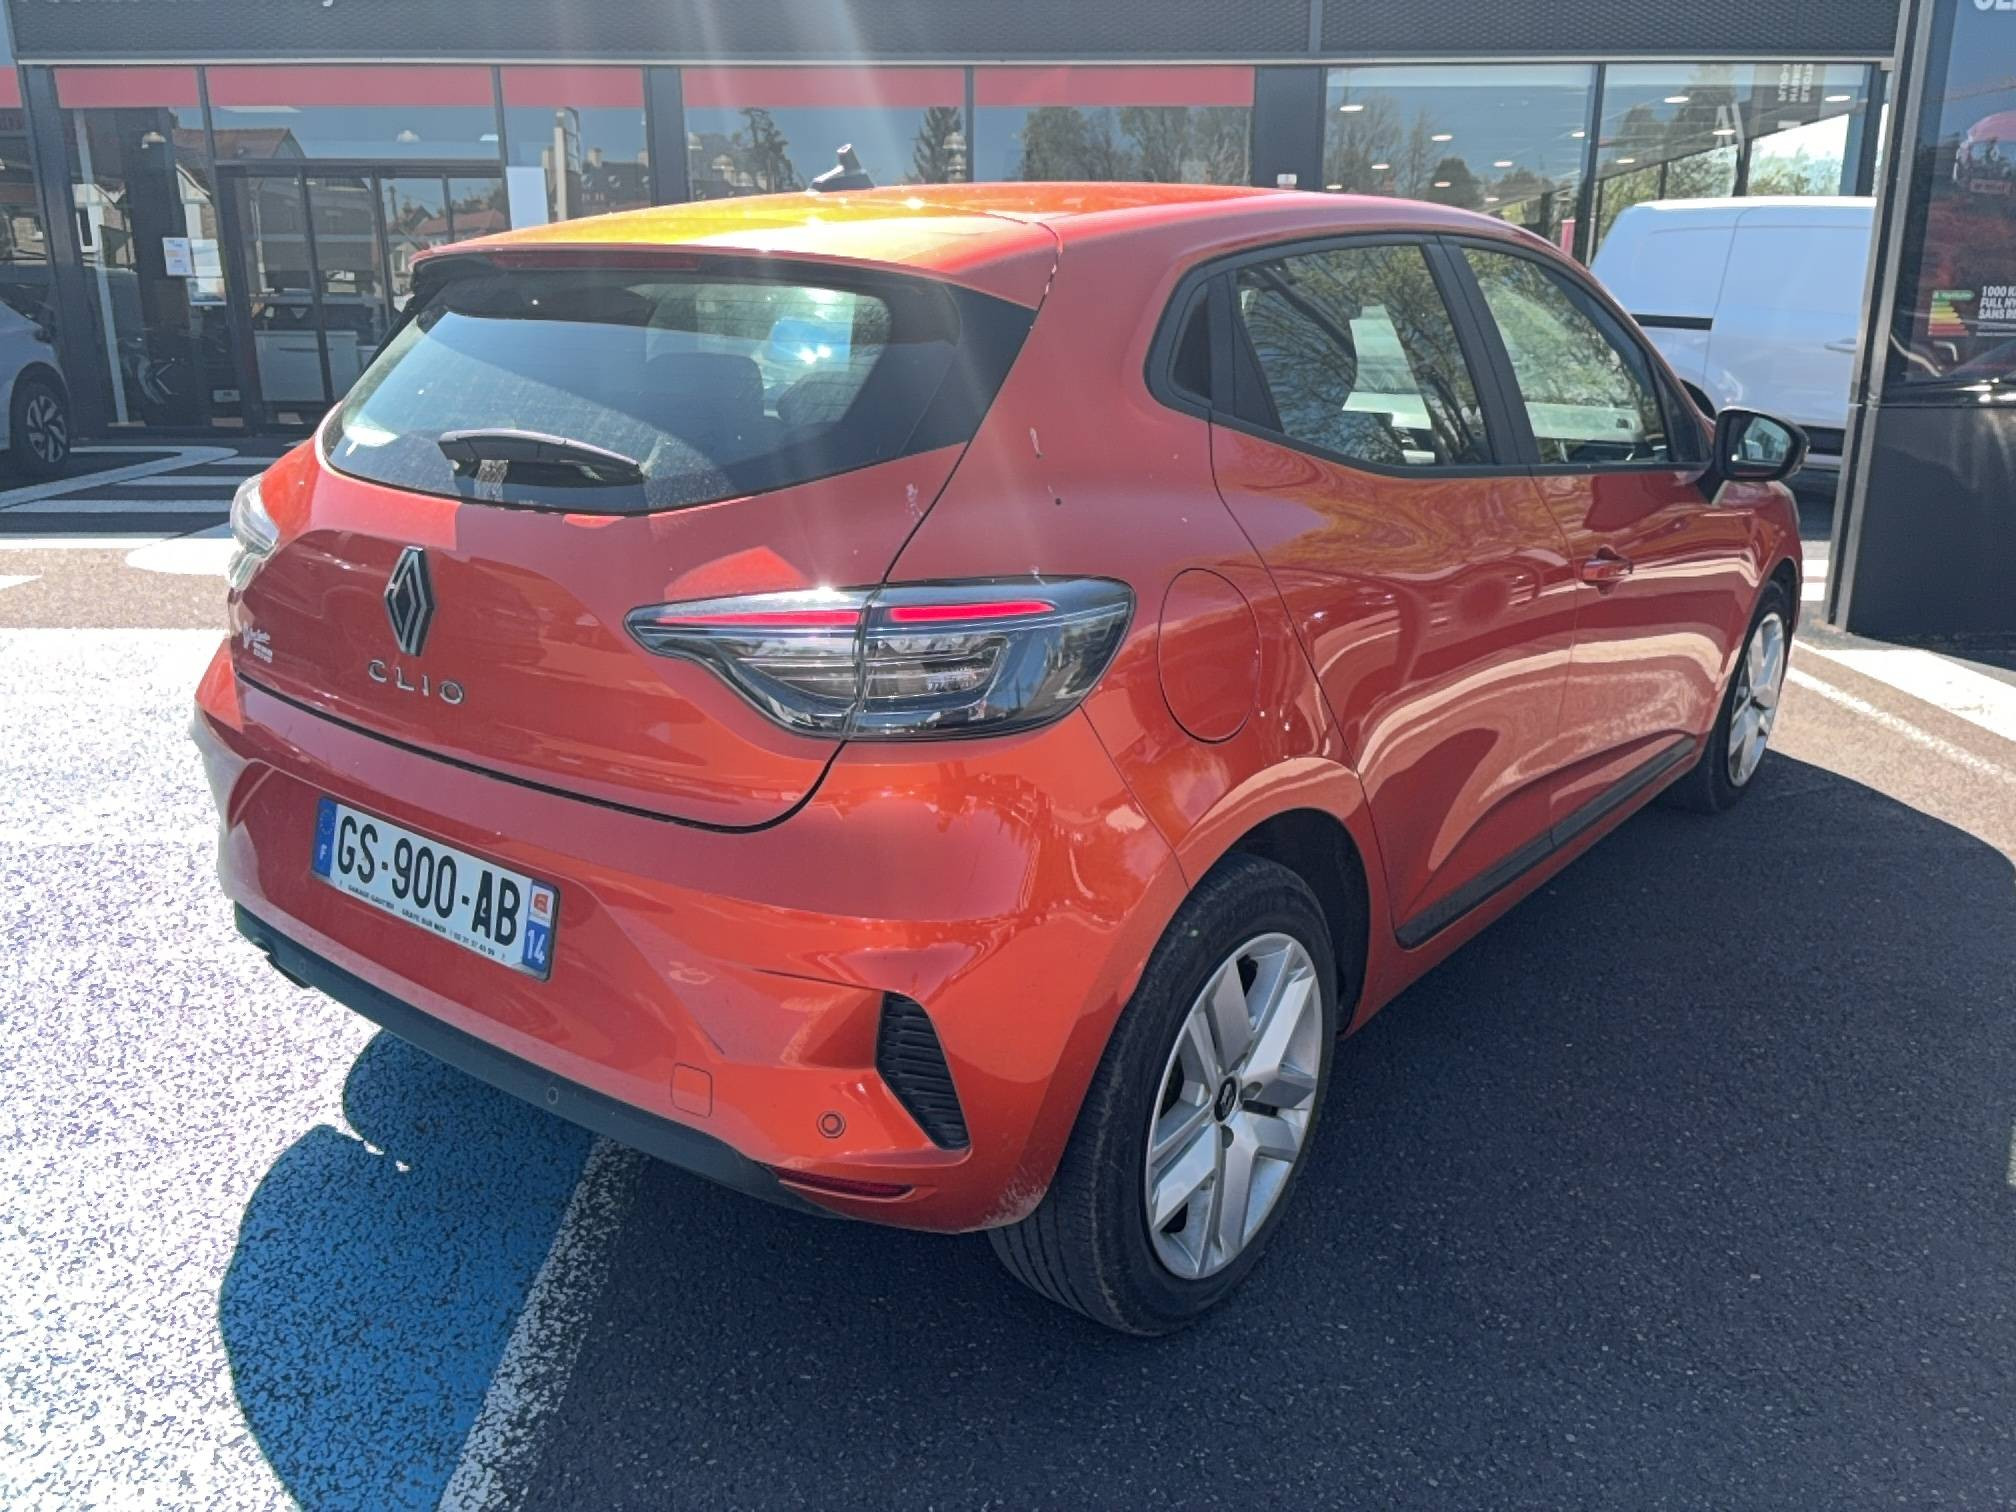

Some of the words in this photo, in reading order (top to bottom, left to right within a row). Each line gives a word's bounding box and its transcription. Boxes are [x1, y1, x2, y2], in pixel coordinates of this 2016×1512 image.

[1980, 297, 2002, 309] FULL
[1982, 285, 2007, 297] 1000
[368, 659, 463, 704] CLIO
[337, 815, 521, 946] GS-900-AB
[527, 929, 545, 964] 14
